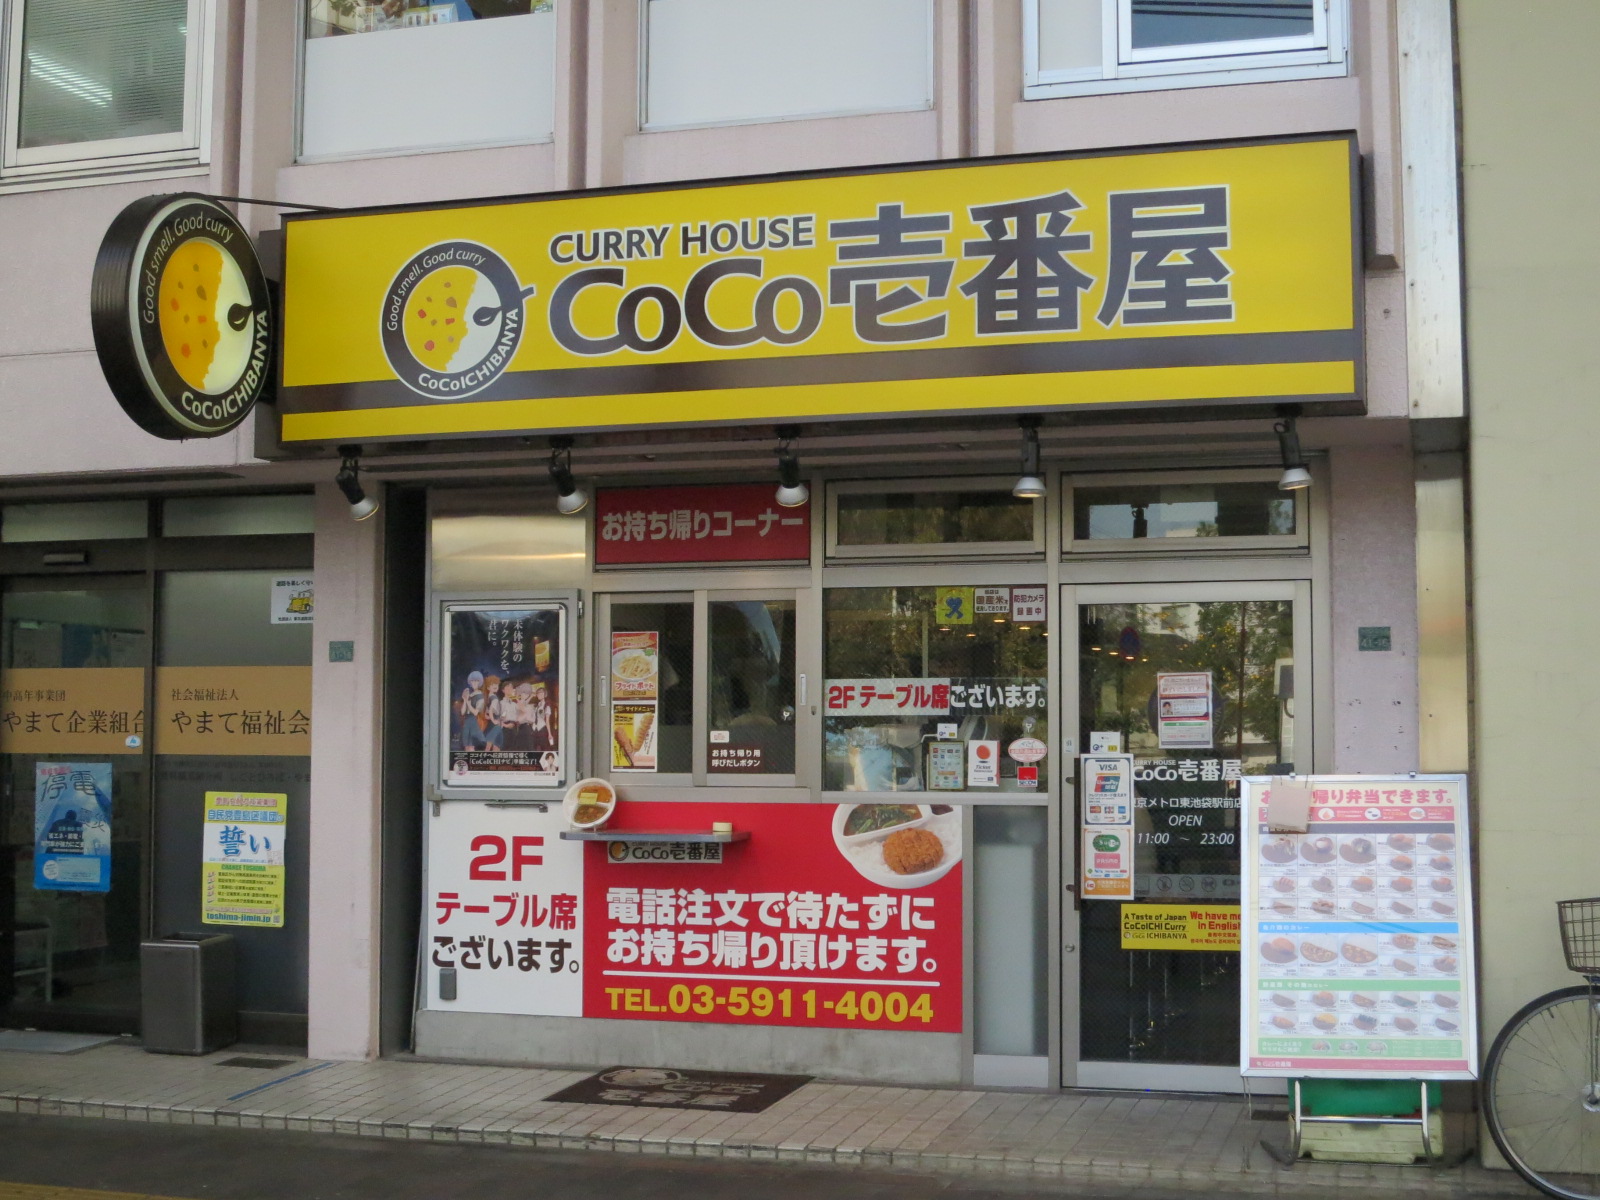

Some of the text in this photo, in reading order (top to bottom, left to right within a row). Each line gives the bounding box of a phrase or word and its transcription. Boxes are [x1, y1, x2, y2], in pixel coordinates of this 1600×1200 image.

[550, 214, 814, 264] CURRY HOUSE
[144, 211, 234, 324] Good smell. Good curry
[387, 248, 487, 331] Good smell. Good curry
[418, 308, 519, 391] CoCoICHIBANYA
[182, 310, 268, 419] CoCoICHIBANYA
[602, 507, 804, 541] お持ち帰りコーナー
[1013, 594, 1044, 603] 防犯カメラ
[1017, 607, 1042, 615] 録画中
[513, 619, 523, 662] 未体験の
[171, 688, 239, 701] 社会福祉法人
[4, 709, 144, 734] やまて企業組合
[171, 710, 310, 735] やまて福祉会
[711, 759, 761, 767] 呼びだしボタン
[712, 749, 761, 757] お持ち帰り用
[1168, 814, 1202, 827] OPEN
[219, 825, 272, 856] 誓い
[632, 842, 720, 860] CoCo壱番屋
[1138, 832, 1169, 844] 11:00
[1200, 832, 1235, 845] 23:00
[469, 834, 544, 881] 2F
[436, 892, 577, 930] テーブル席
[606, 887, 935, 930] 電話注文で待たずに
[1164, 914, 1187, 922] Japan
[1190, 911, 1203, 920] We
[1205, 911, 1228, 920] have
[1124, 922, 1187, 931] CoCoICHI Curry
[1146, 932, 1188, 940] ICHIBANYA
[432, 935, 580, 973] ございます。
[606, 928, 938, 973] お持ち帰り頂けます。
[604, 983, 934, 1023] TEL.03-5911-4004
